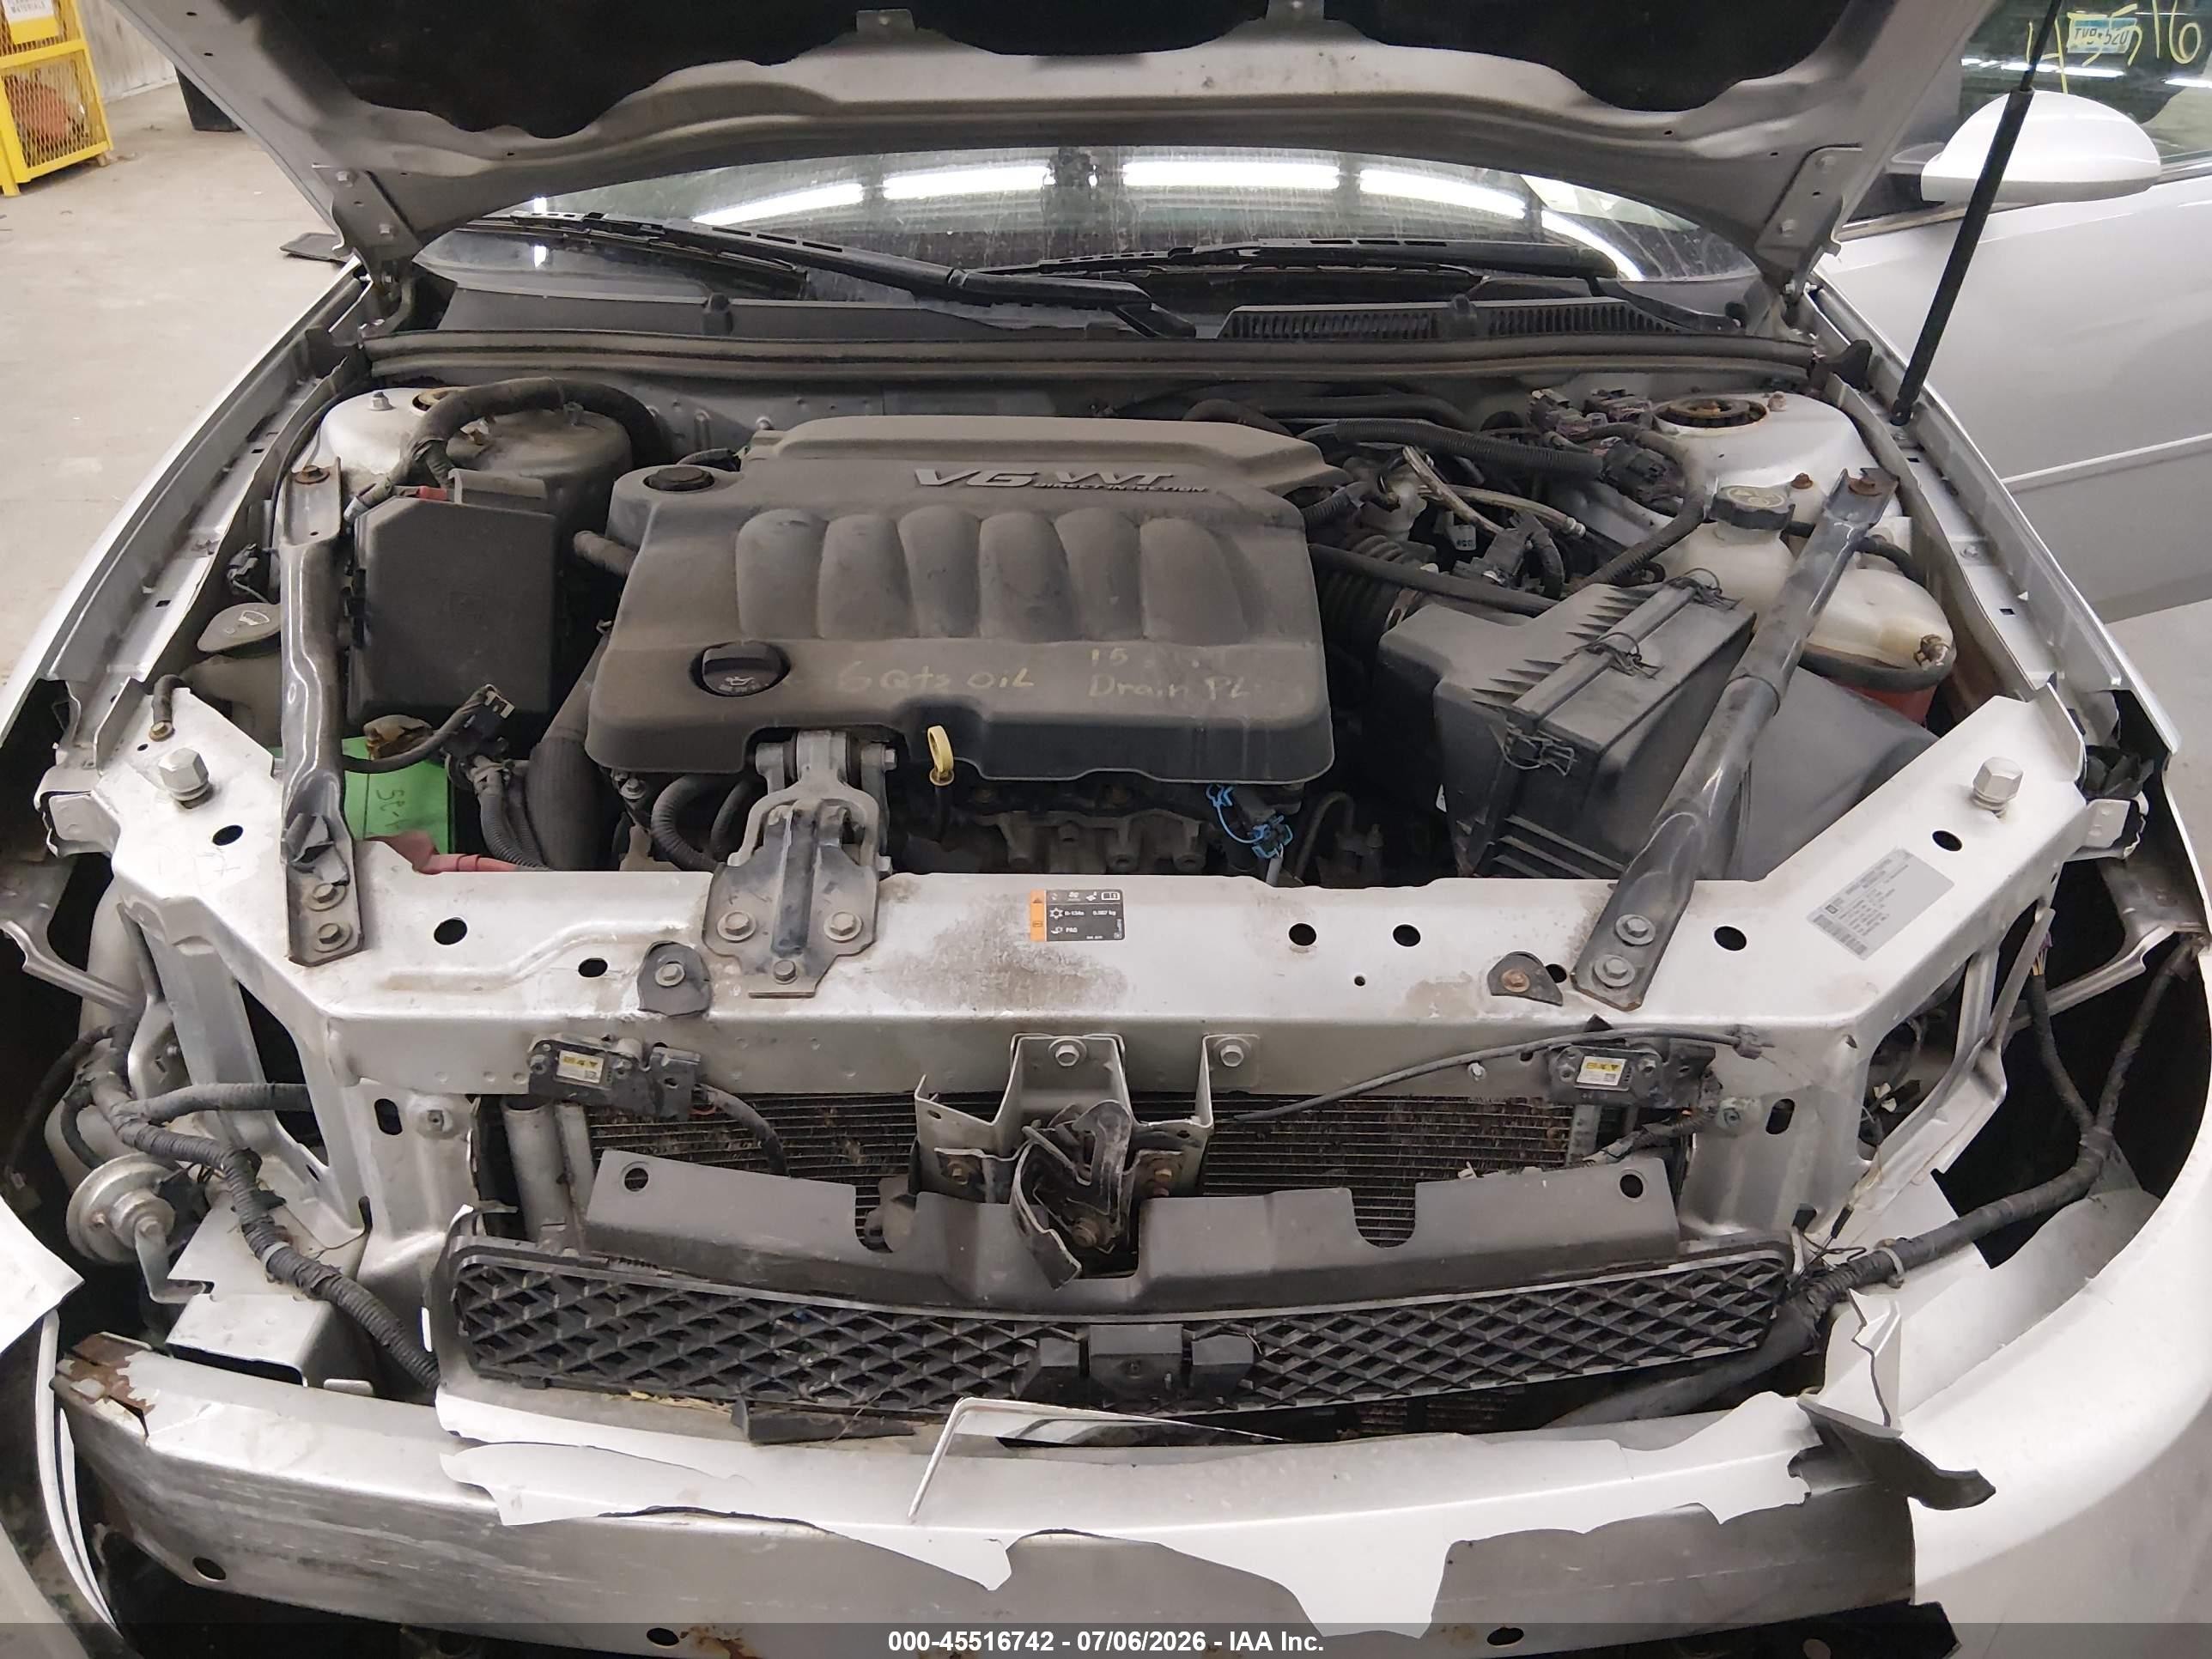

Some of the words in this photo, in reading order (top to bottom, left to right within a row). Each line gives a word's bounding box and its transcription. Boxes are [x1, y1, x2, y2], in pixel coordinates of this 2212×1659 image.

[915, 468, 1038, 488] V6
[837, 659, 873, 694] 6
[1087, 673, 1190, 699] Drain
